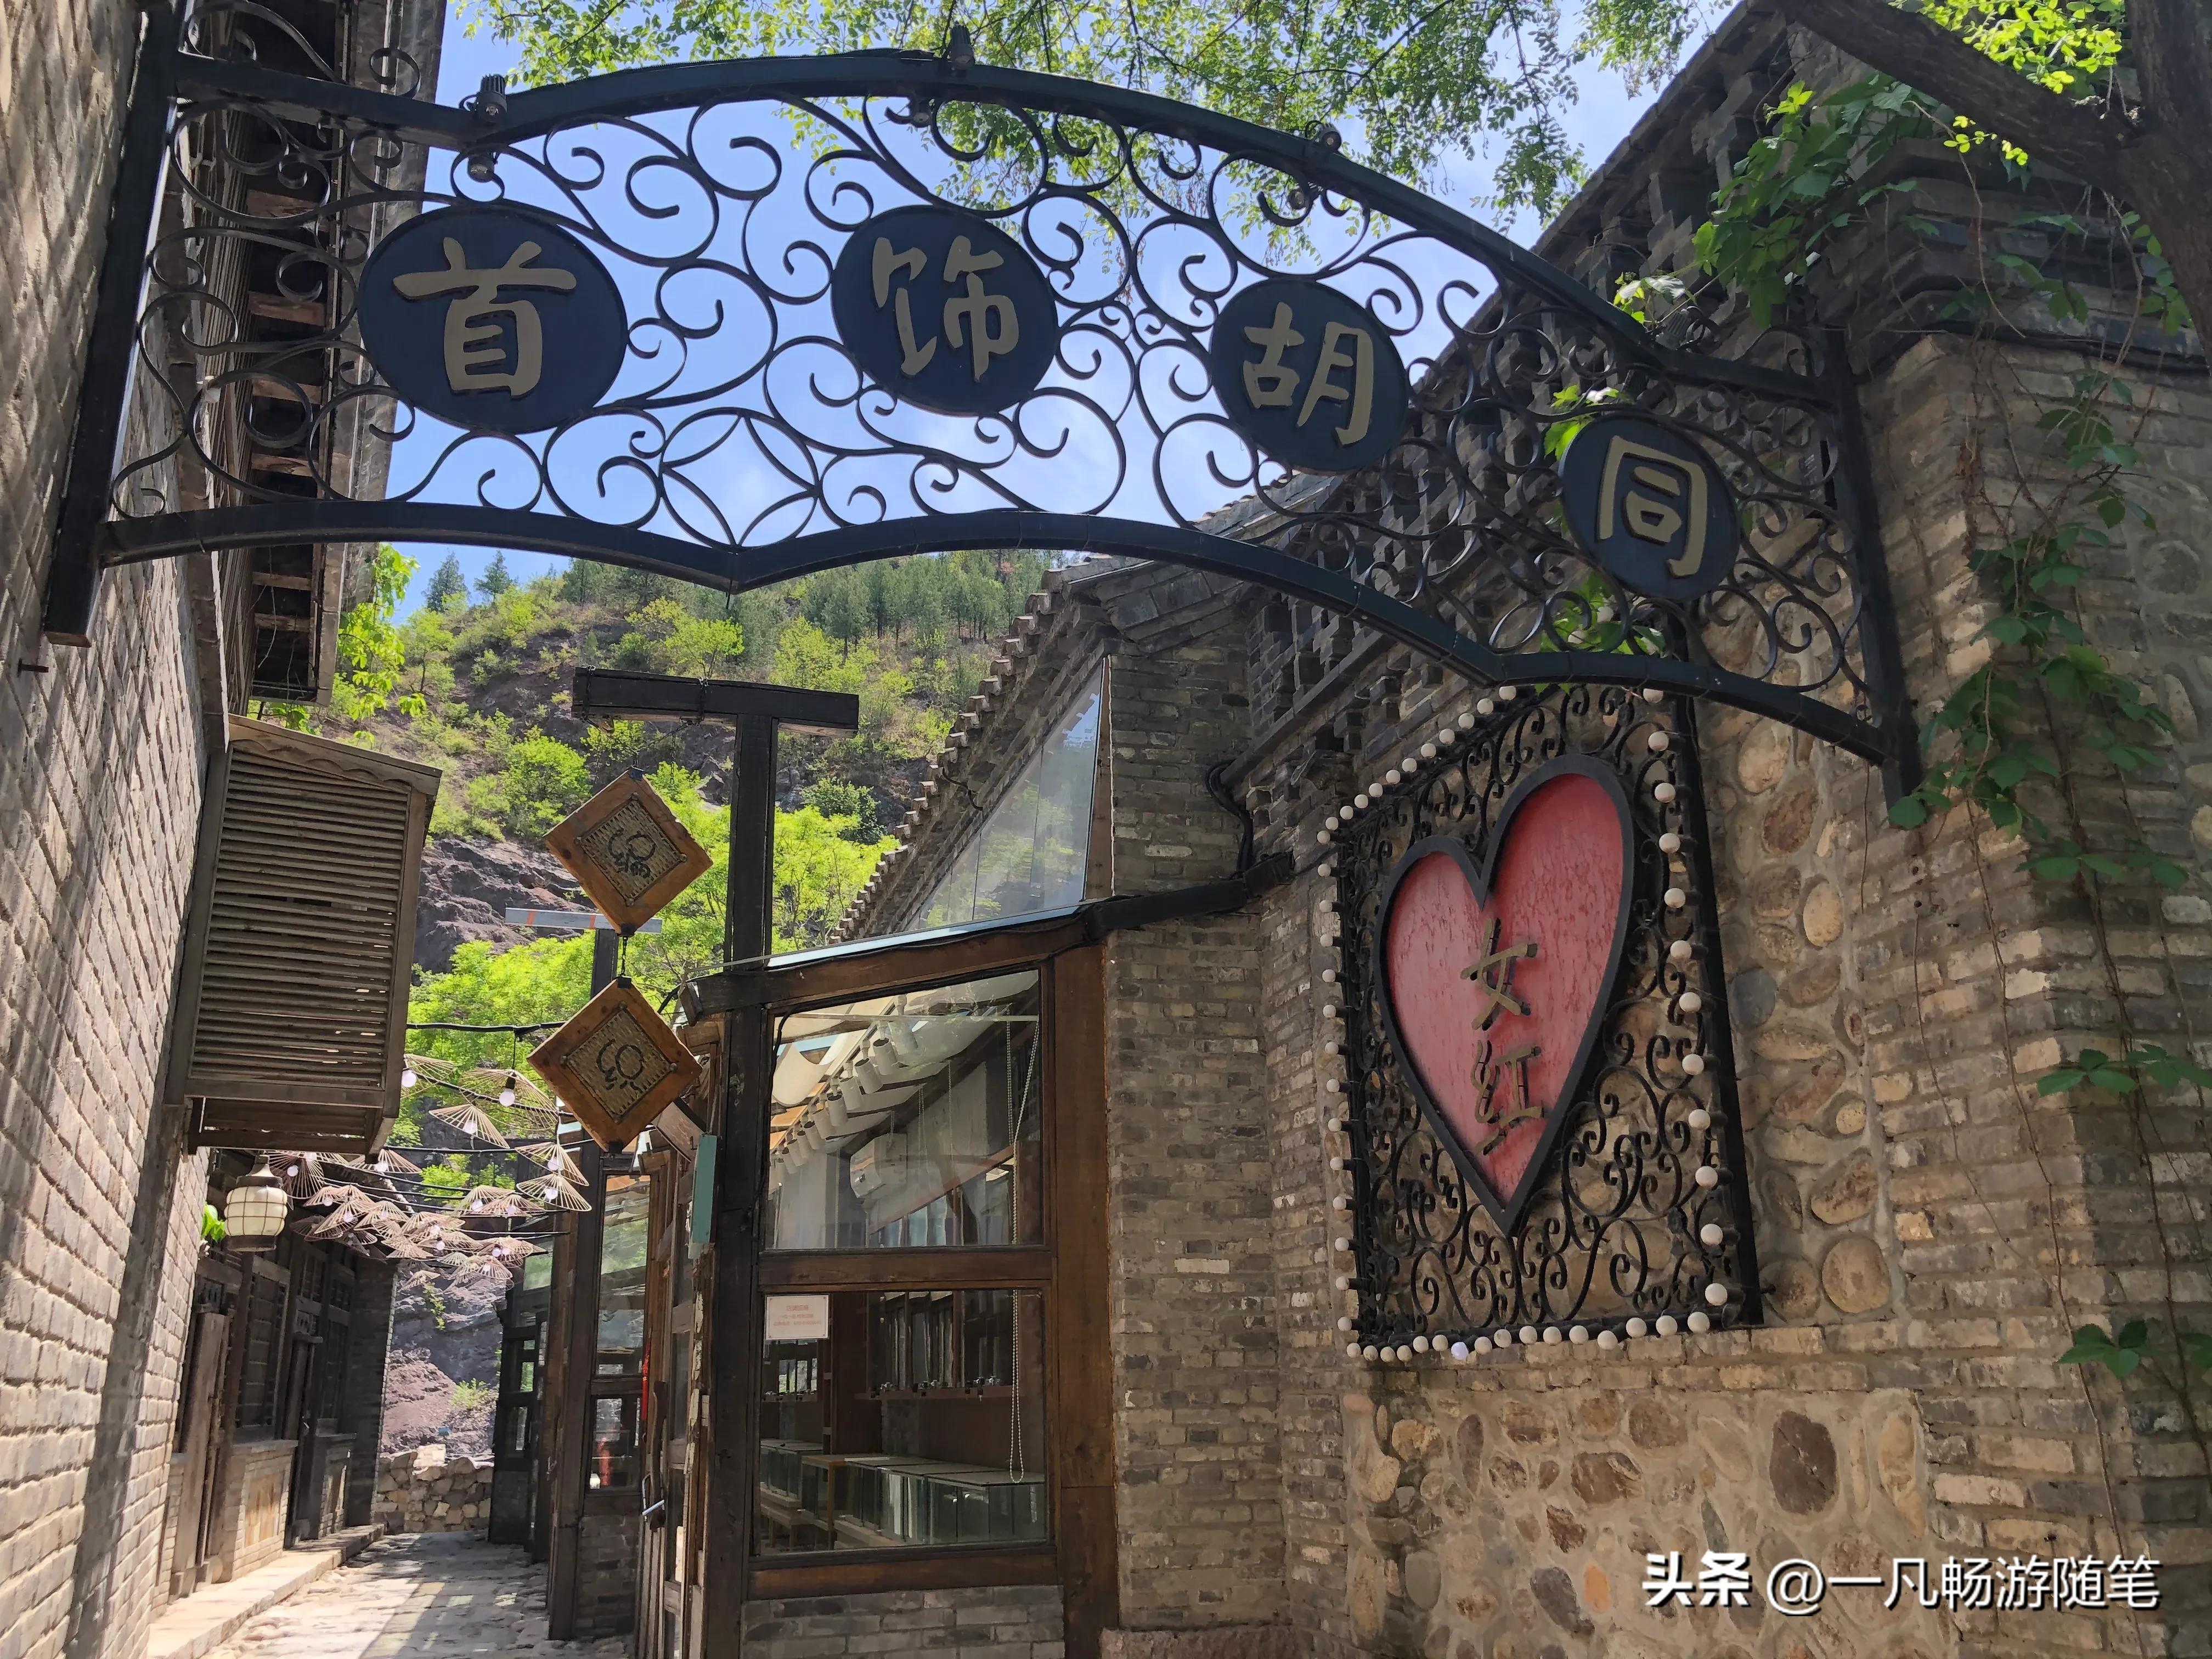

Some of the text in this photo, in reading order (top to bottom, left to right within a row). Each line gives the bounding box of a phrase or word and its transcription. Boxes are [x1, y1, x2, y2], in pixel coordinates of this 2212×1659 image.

[392, 235, 1707, 578] 首饰胡同
[1459, 917, 1545, 1152] 女红
